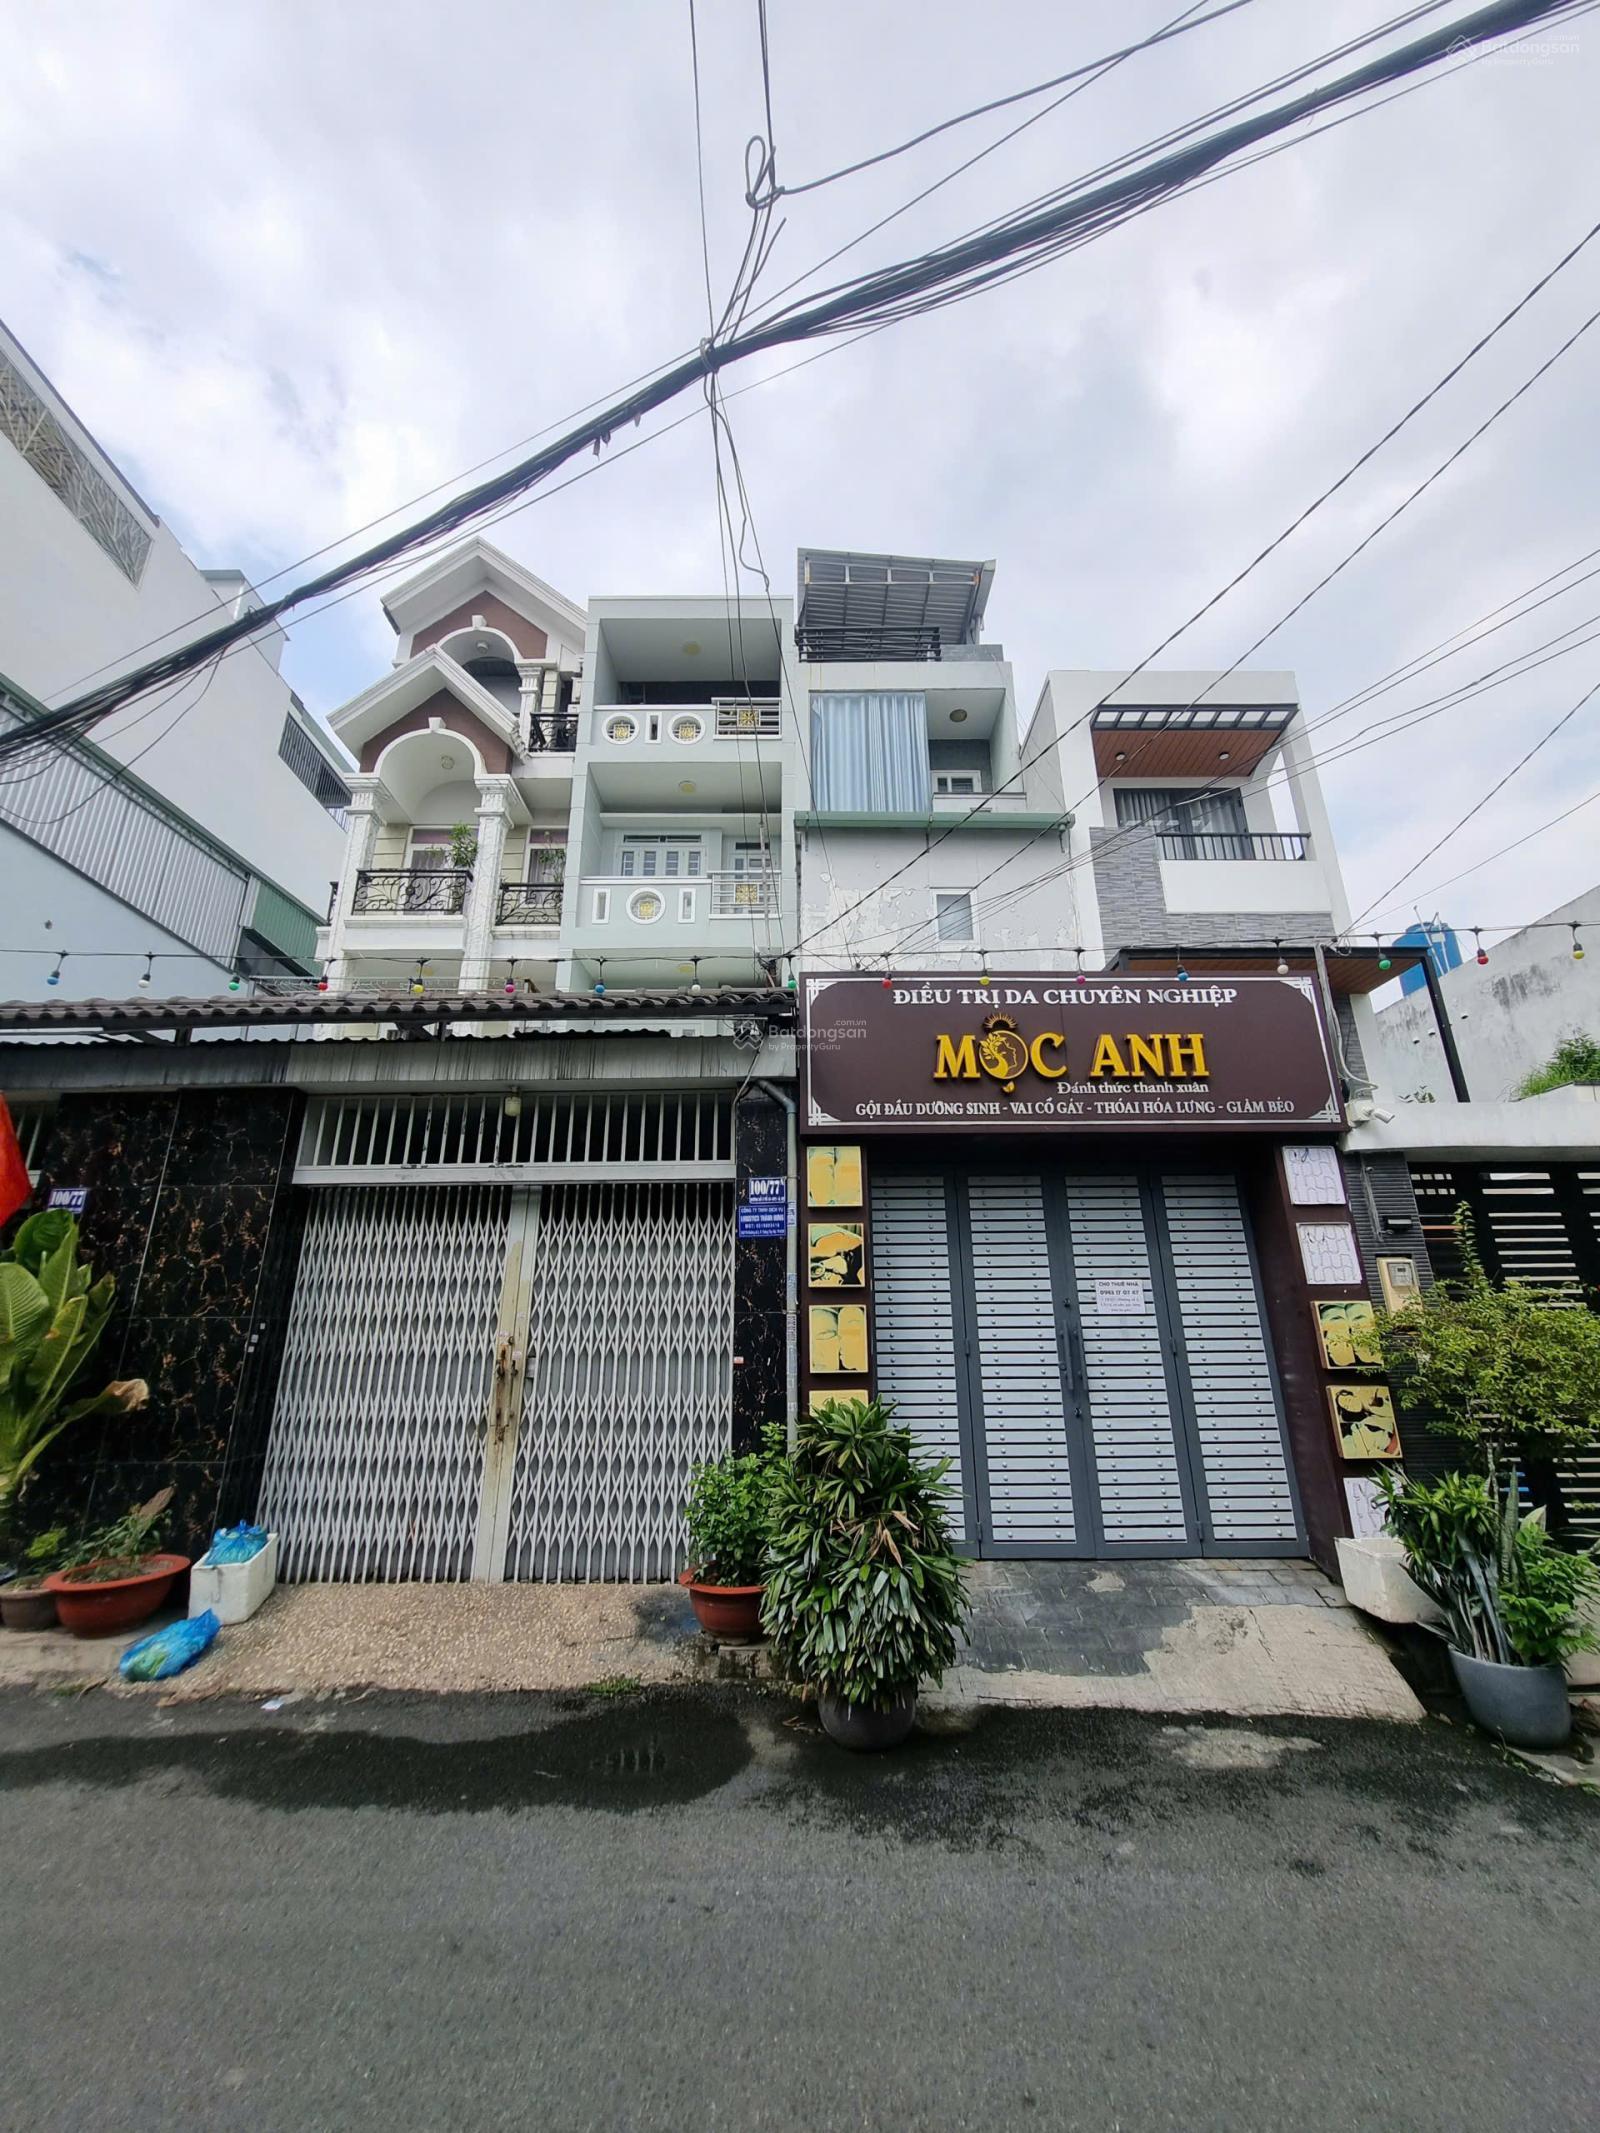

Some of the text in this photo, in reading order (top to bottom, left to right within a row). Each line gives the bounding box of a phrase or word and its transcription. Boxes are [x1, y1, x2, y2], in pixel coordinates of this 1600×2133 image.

[893, 982, 1237, 1009] ĐIỀU TRỊ DA CHUYÊN NGHIỆP
[1090, 1033, 1210, 1078] ANH
[1057, 1081, 1209, 1094] Đánh thức thanh xuân
[855, 1099, 881, 1119] GỘI
[915, 1100, 963, 1115] DƯỠNG
[966, 1102, 1001, 1115] SINH
[1009, 1102, 1033, 1114] VAI
[1142, 1097, 1174, 1114] HÓA
[1176, 1100, 1216, 1113] LƯNG
[50, 1190, 85, 1205] 100/77
